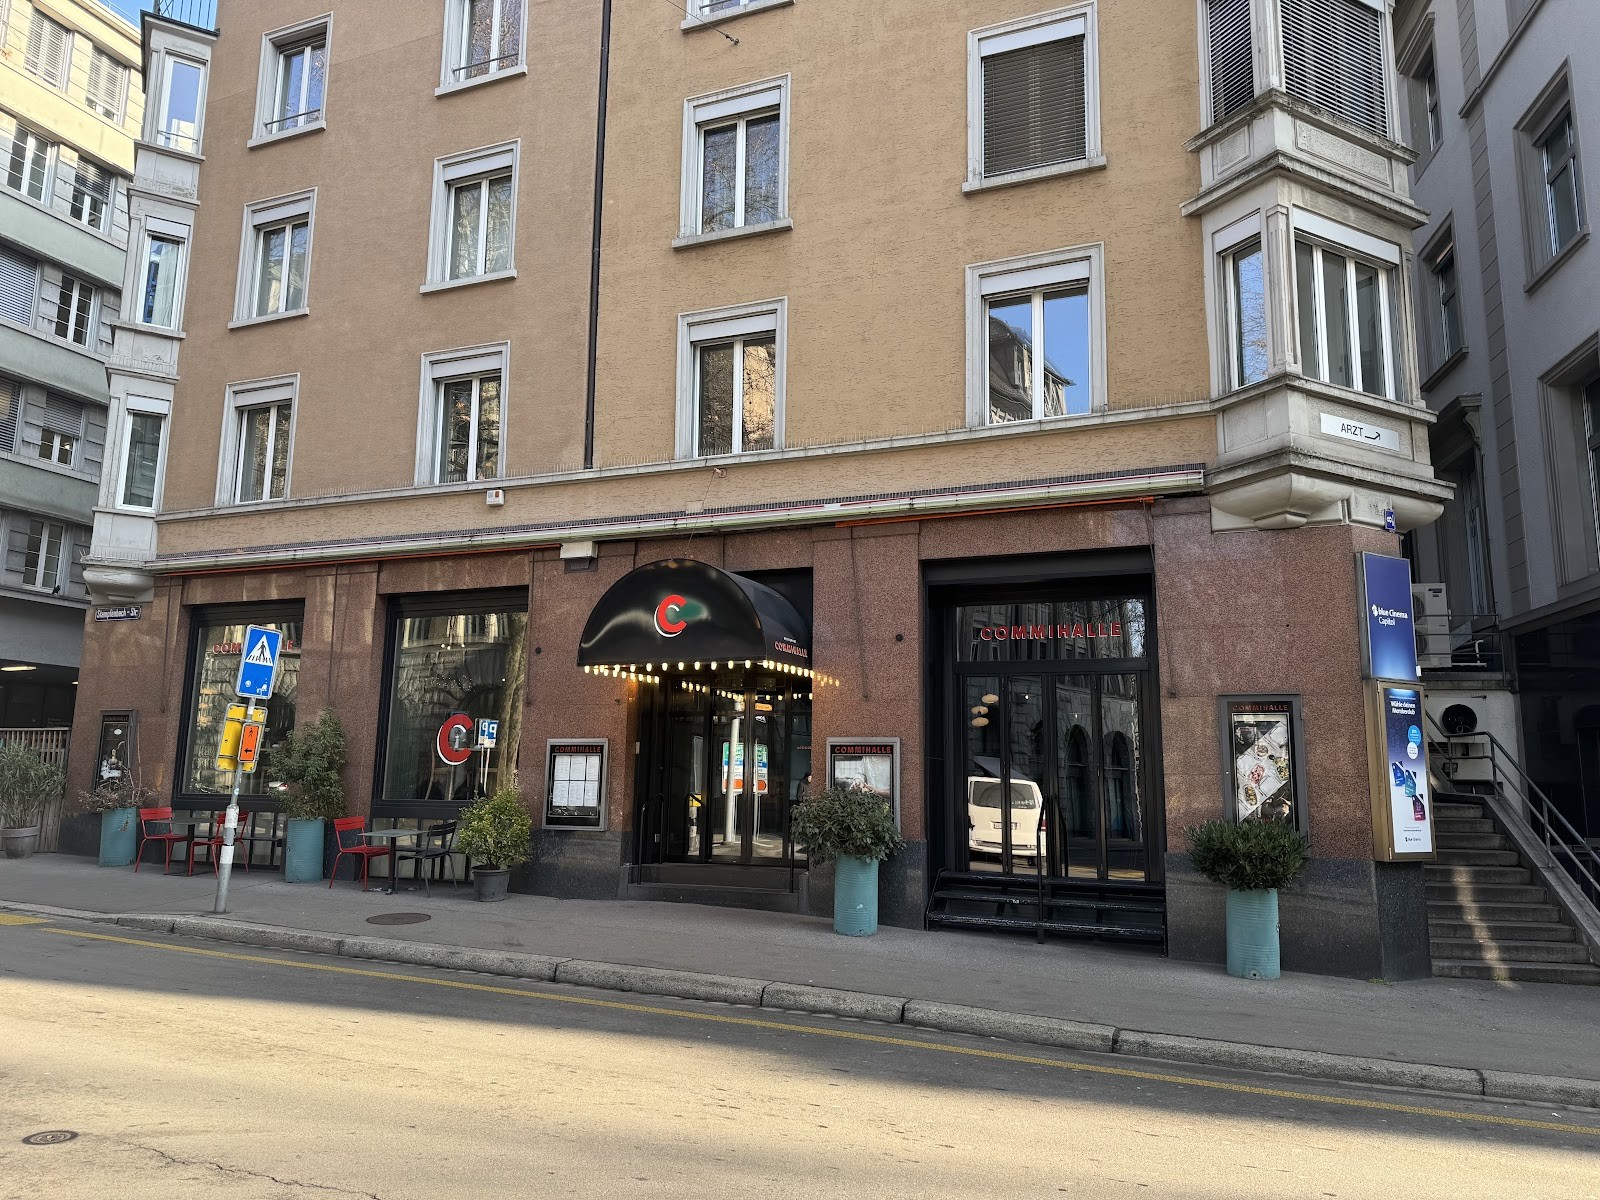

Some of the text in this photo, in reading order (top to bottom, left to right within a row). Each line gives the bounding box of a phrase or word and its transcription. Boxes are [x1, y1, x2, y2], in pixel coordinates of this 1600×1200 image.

[1340, 422, 1364, 437] ARZT
[654, 594, 687, 638] C
[1379, 616, 1395, 626] Capitol
[1389, 609, 1408, 619] Cinema
[980, 622, 1121, 641] COMMIHALLE
[437, 713, 473, 766] C
